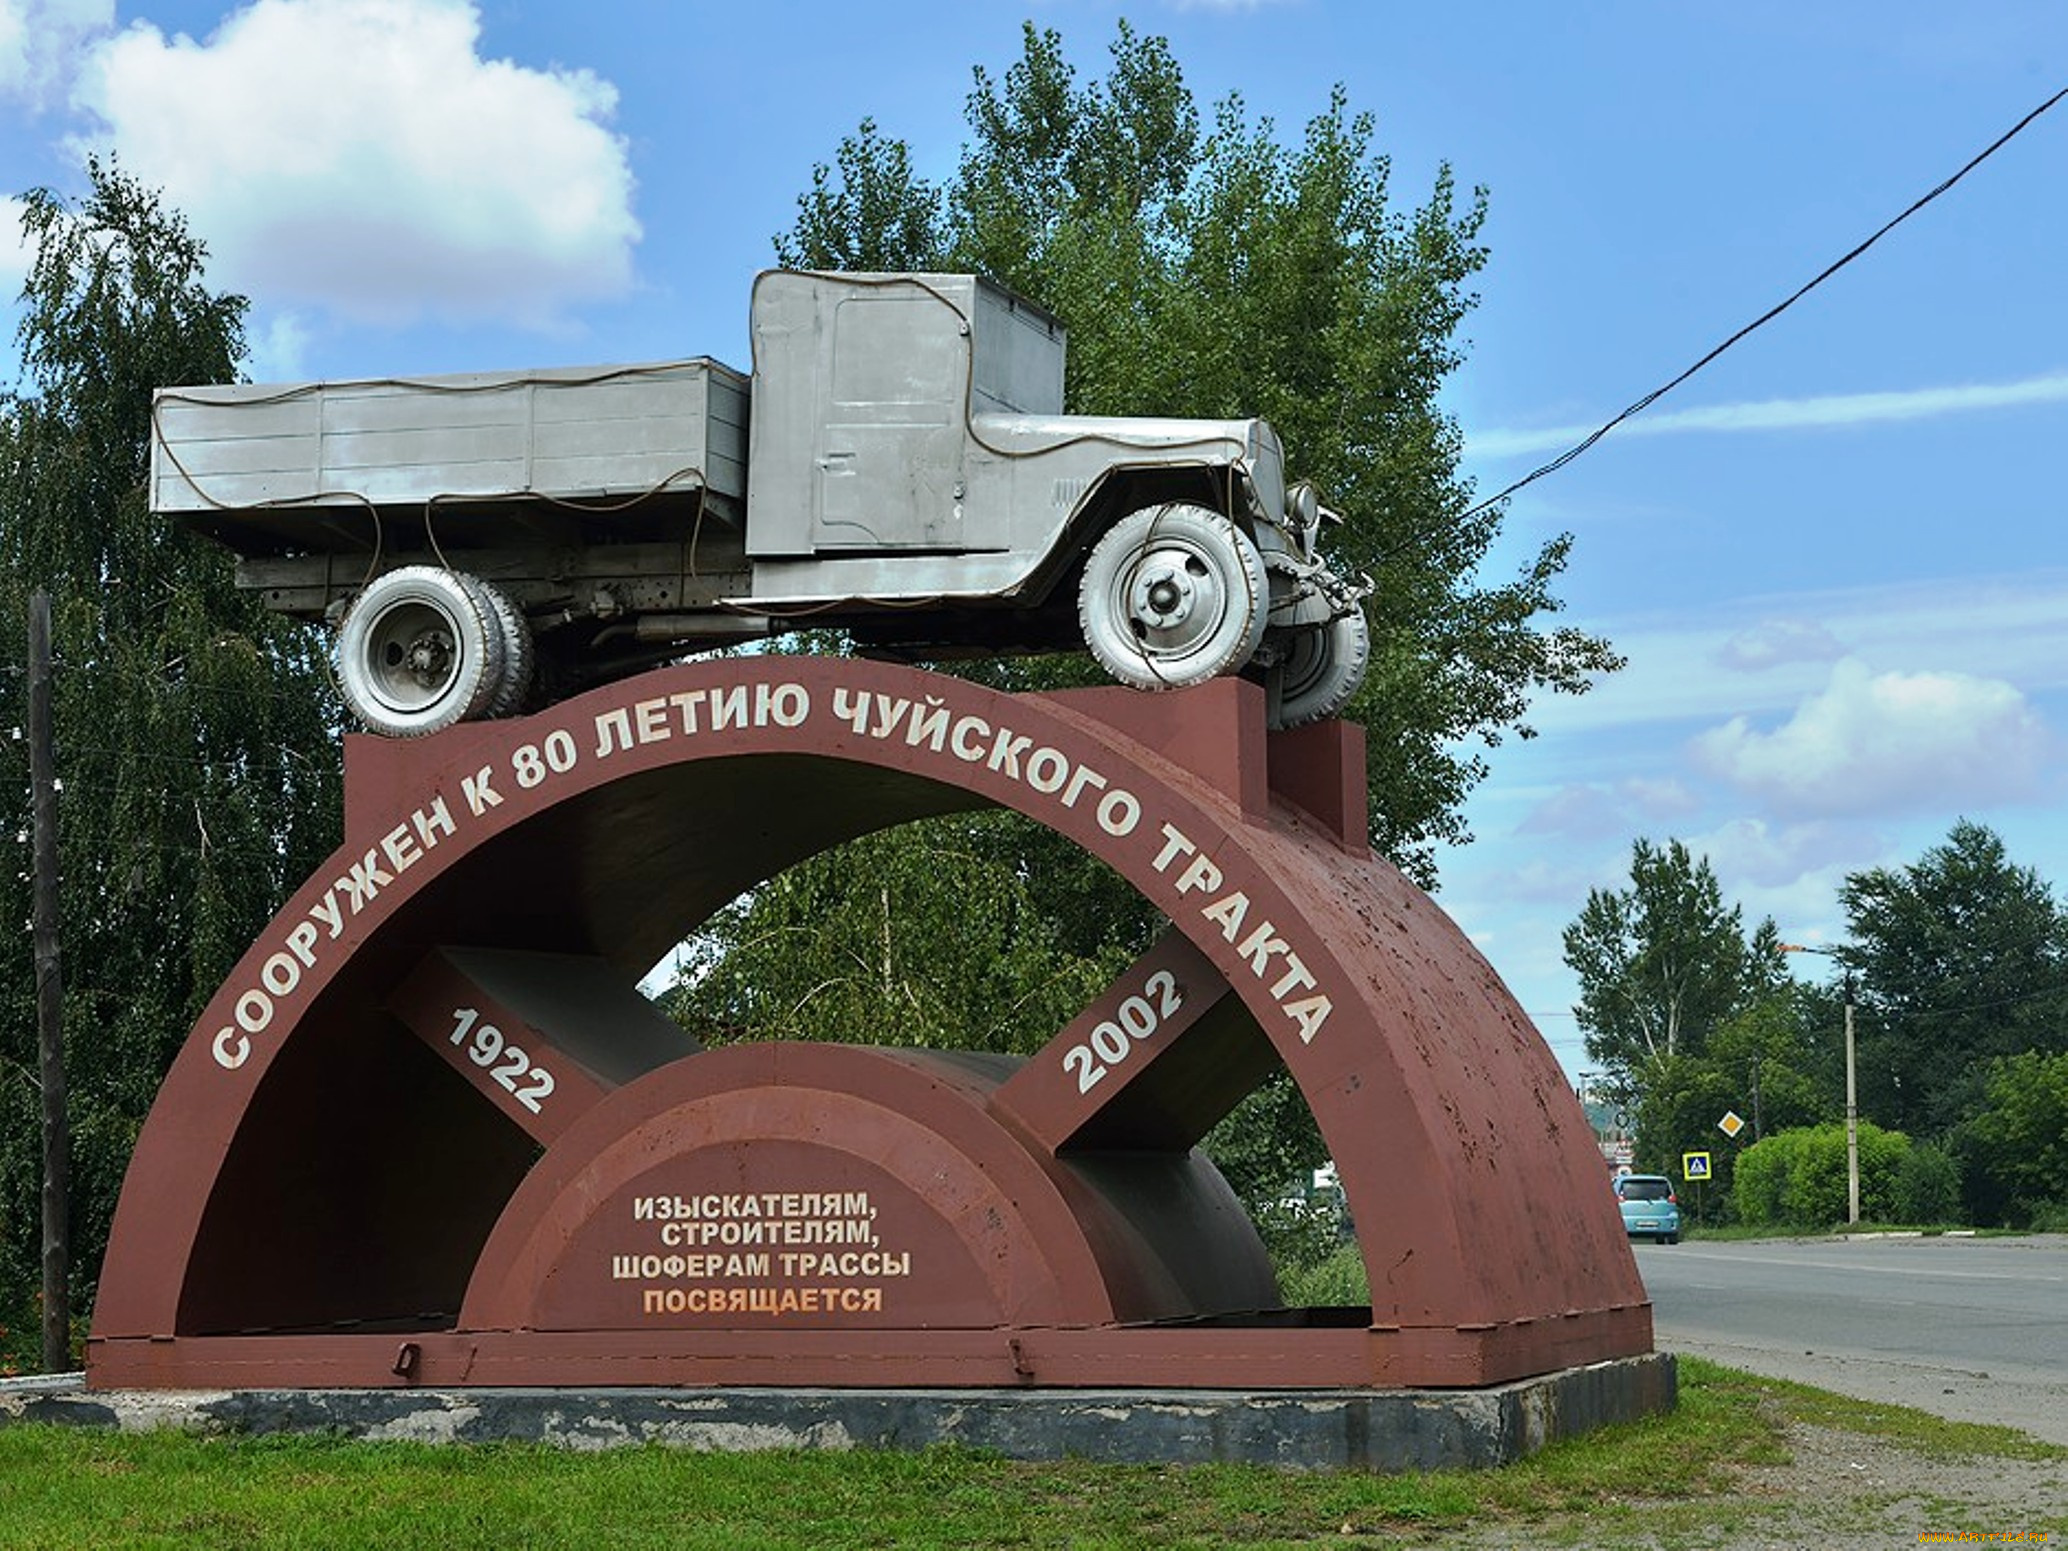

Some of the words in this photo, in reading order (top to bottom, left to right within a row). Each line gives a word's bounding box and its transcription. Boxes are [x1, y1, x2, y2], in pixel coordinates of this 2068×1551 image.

[211, 796, 458, 1070] СООРУЖЕН
[460, 764, 505, 817] К
[511, 729, 577, 789] 80
[594, 683, 810, 758] ЛЕТИЮ
[832, 686, 1142, 838] ЧУЙСКОГО
[1151, 822, 1335, 1045] ТРАКТА
[1062, 969, 1183, 1095] 2002
[450, 1008, 556, 1114] 1922
[633, 1192, 878, 1220] ИЗЫСКАТЕЛЯМ,
[660, 1219, 880, 1248] СТРОИТЕЛЯМ,
[612, 1252, 770, 1279] ШОФЕРАМ
[778, 1252, 911, 1277] ТРАССЫ
[643, 1287, 883, 1315] ПОСВЯЩАЕТСЯ
